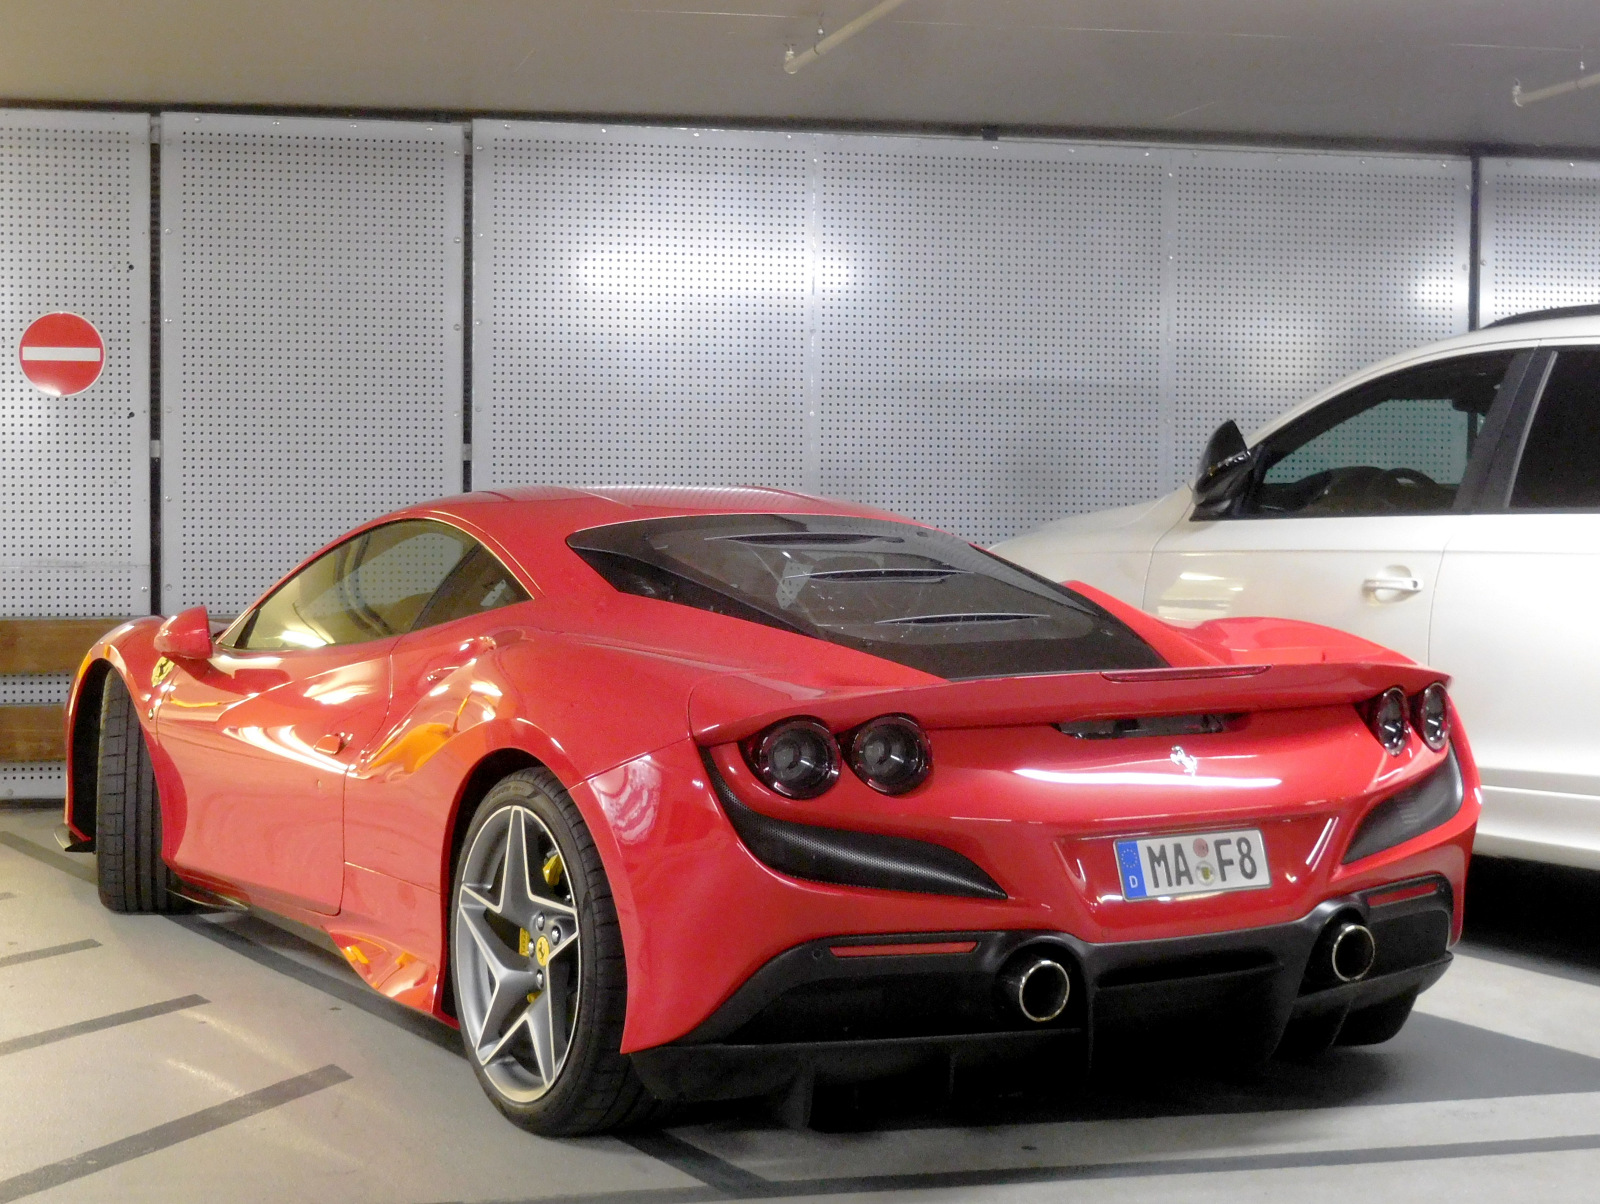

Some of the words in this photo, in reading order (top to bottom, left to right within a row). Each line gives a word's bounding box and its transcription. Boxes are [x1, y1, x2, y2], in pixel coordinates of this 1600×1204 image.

[1146, 843, 1194, 888] MA
[1213, 837, 1257, 882] F8
[1129, 875, 1139, 888] D
